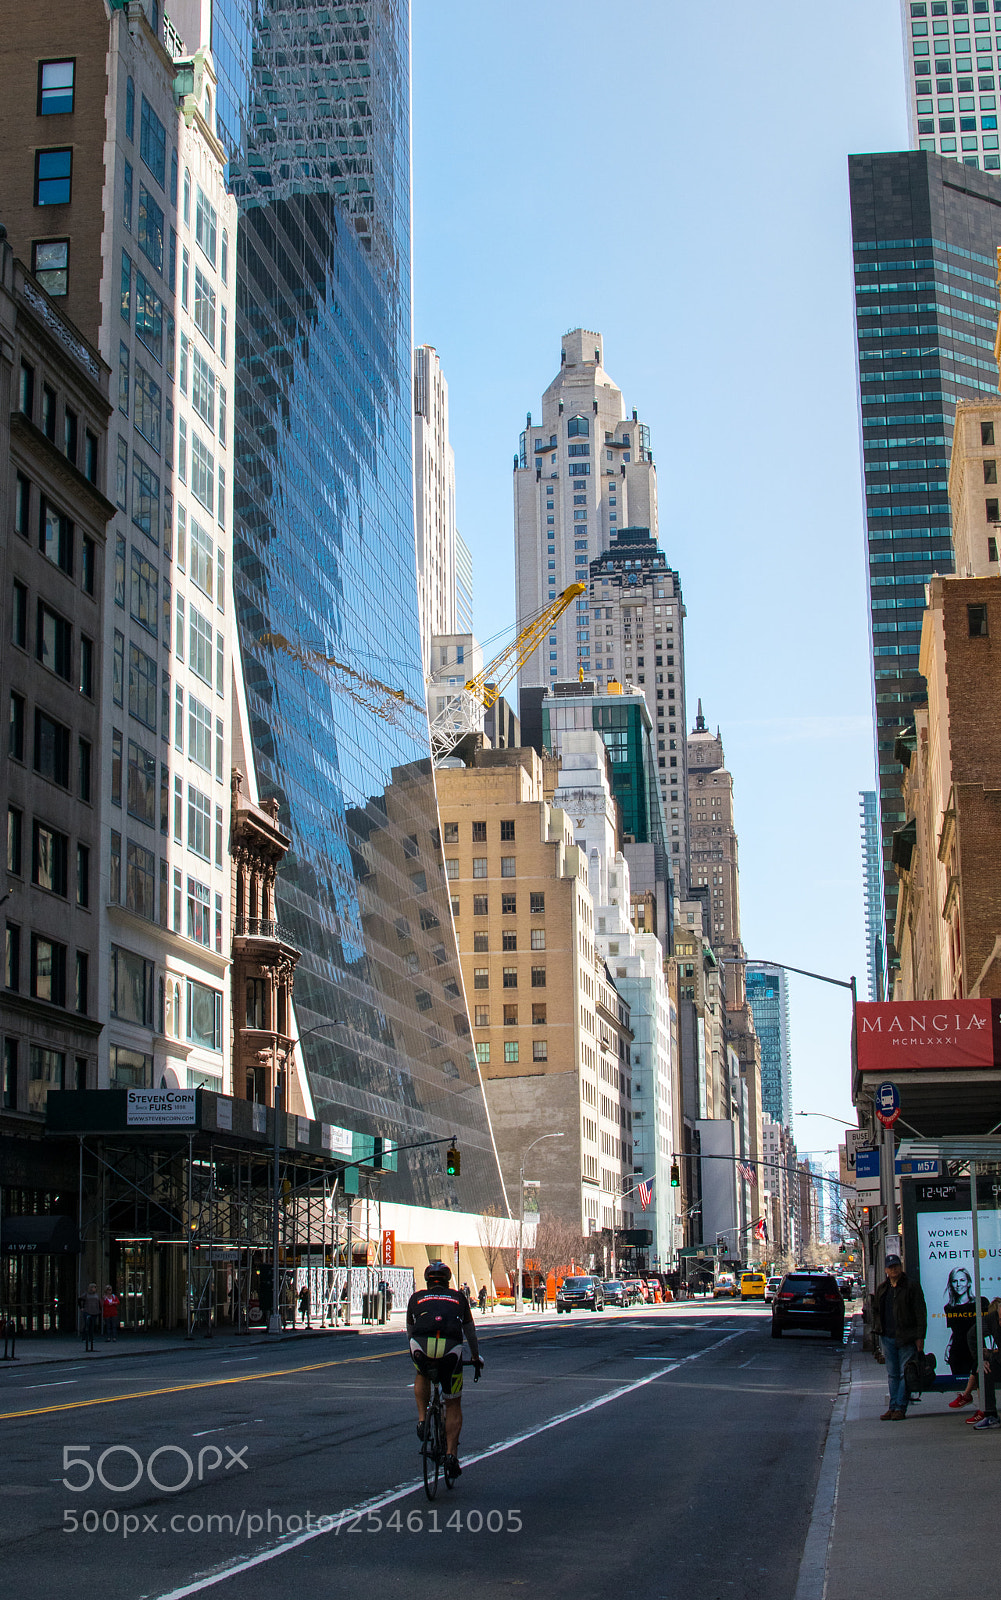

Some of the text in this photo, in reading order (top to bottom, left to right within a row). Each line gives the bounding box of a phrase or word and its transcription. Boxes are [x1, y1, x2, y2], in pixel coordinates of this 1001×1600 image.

[862, 1013, 983, 1033] MANGIA
[892, 1037, 957, 1046] MCMLXXXI
[149, 1103, 173, 1111] FURS
[917, 1161, 935, 1171] M57
[928, 1229, 968, 1238] WOMEN
[928, 1240, 950, 1248] ARE
